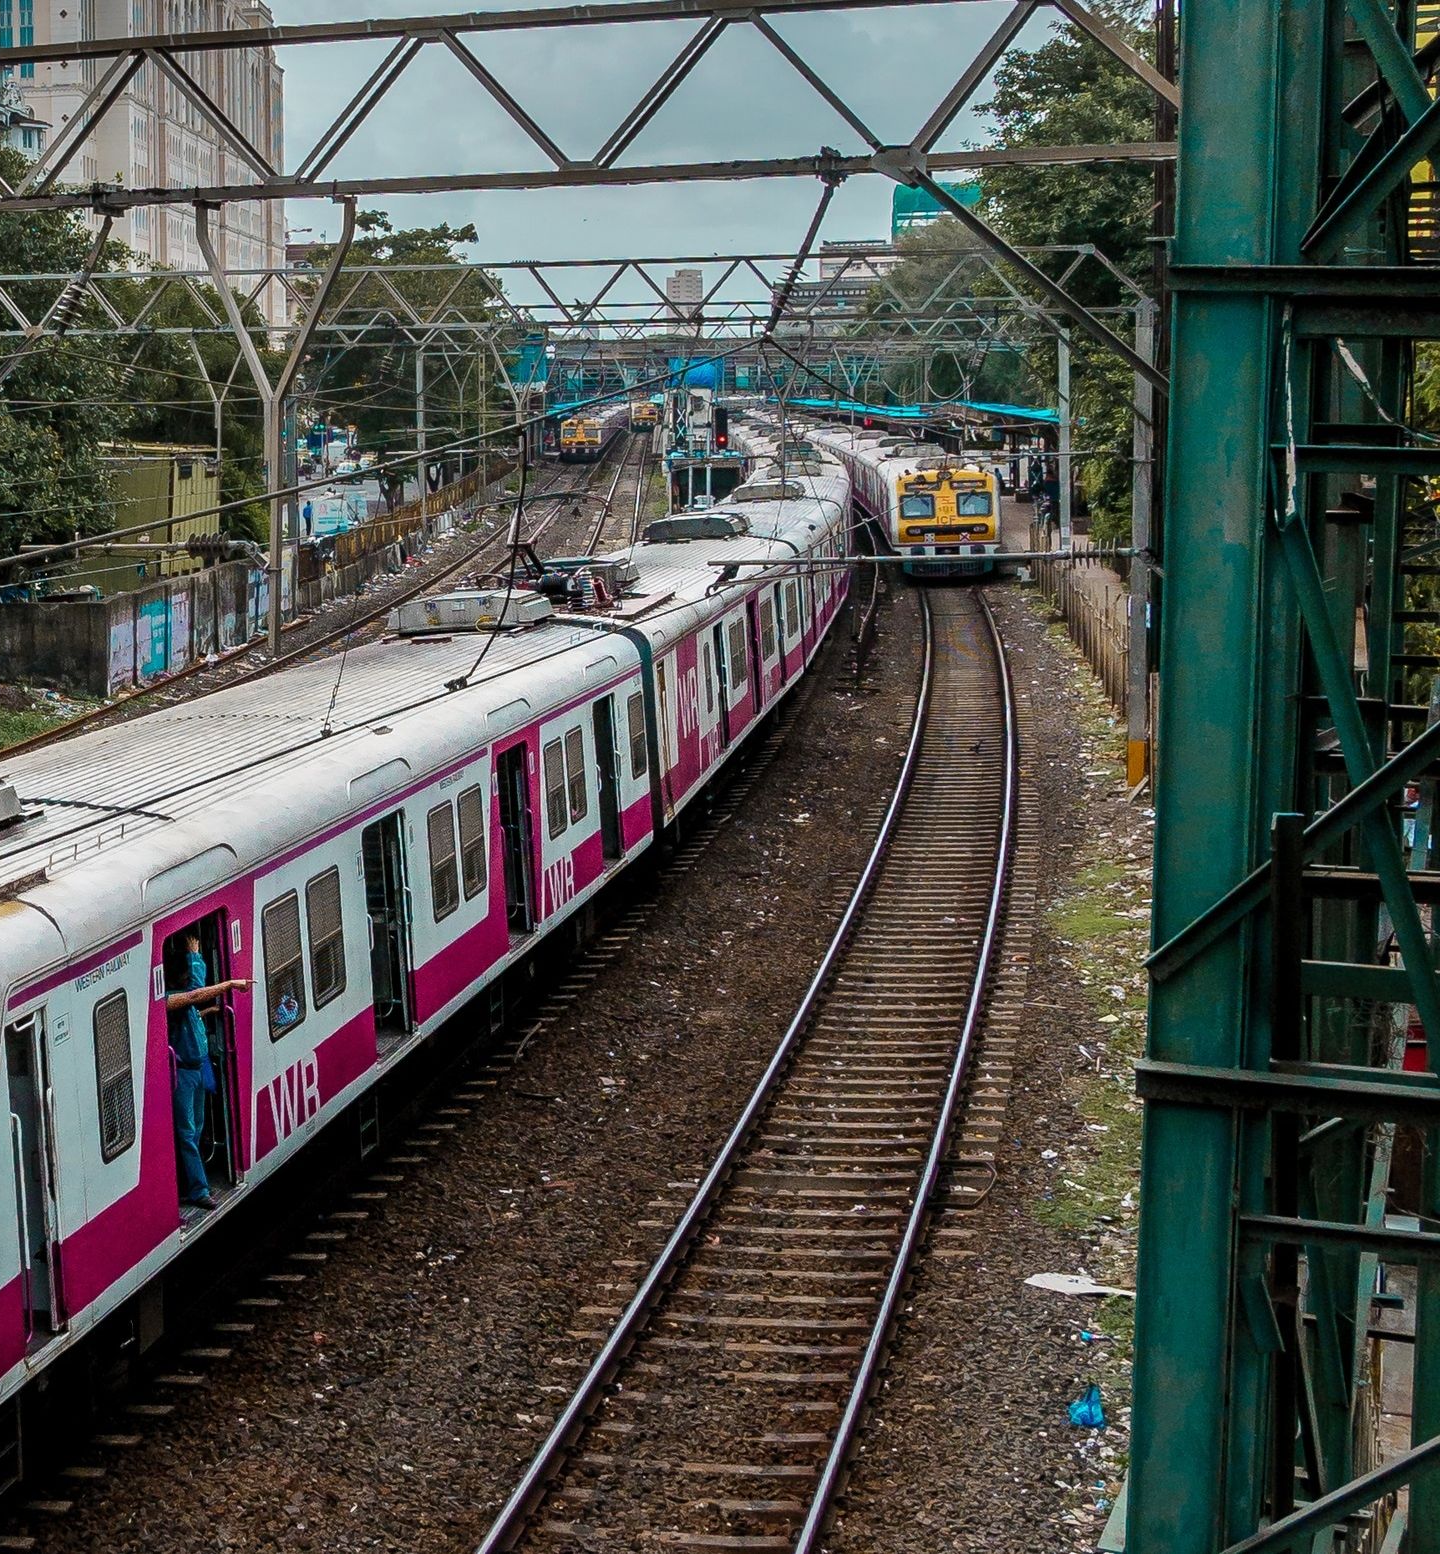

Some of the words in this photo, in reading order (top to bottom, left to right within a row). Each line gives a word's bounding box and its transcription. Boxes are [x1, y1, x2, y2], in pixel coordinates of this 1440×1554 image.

[936, 515, 957, 525] ICF
[75, 967, 104, 992] WESTERN
[105, 951, 131, 976] RAILWAY
[267, 1049, 322, 1143] WR
